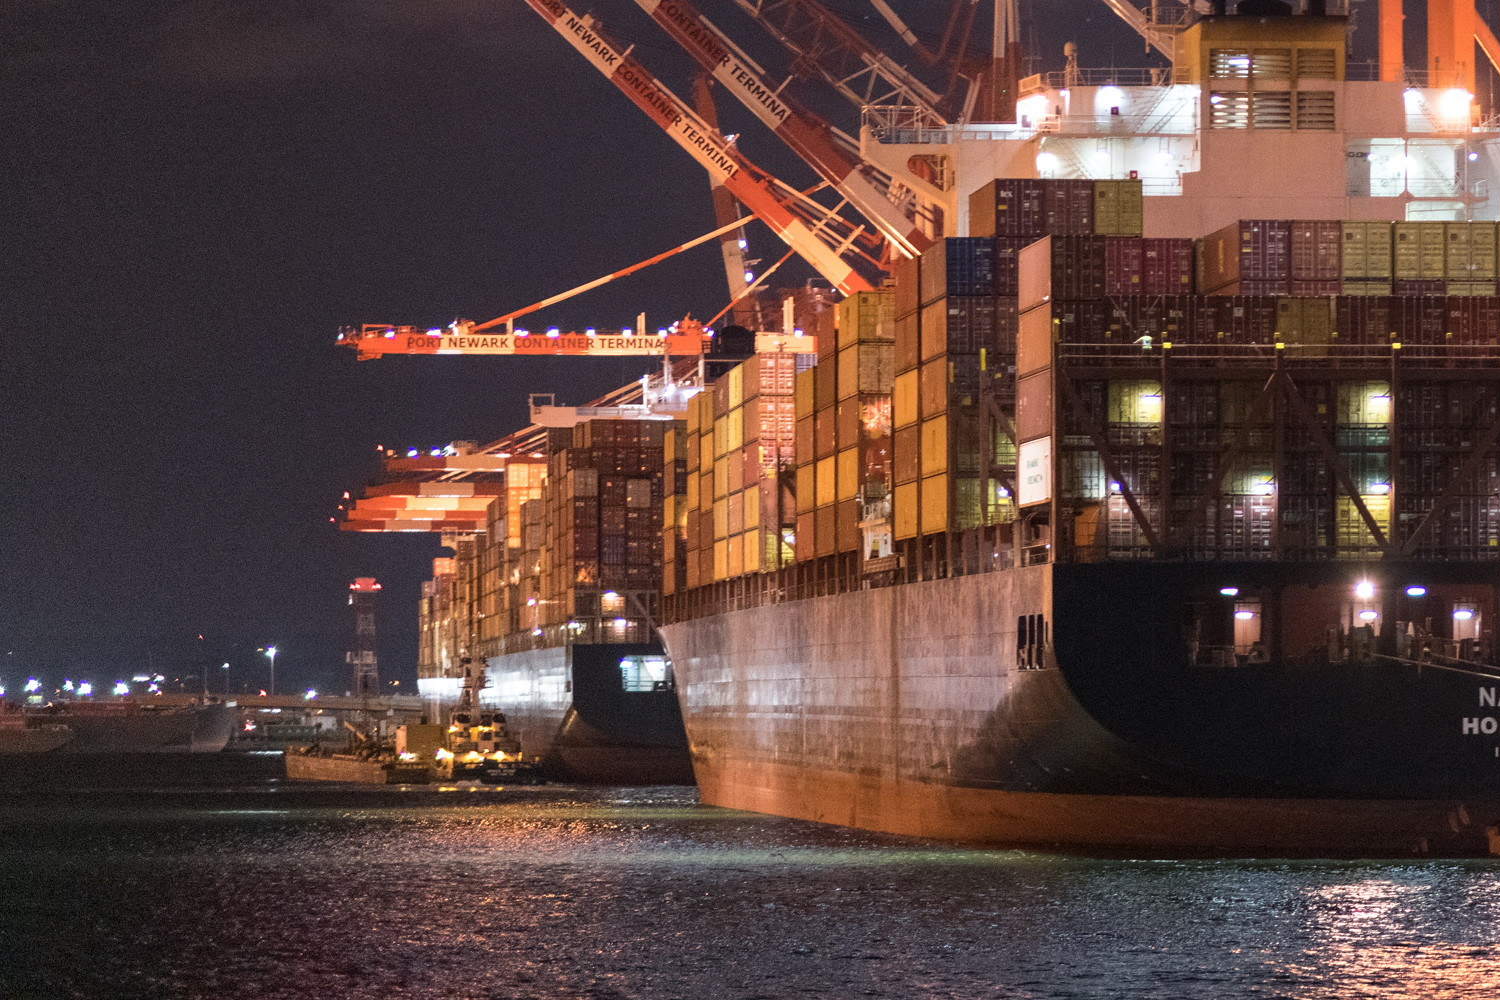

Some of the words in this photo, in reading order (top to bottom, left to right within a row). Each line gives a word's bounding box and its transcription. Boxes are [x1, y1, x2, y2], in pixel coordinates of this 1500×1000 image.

[659, 0, 731, 67] CONTAINER
[566, 17, 617, 66] NEWARK
[617, 63, 682, 127] CONTAINER
[682, 123, 740, 180] TERMINAL
[407, 337, 443, 348] PORT
[449, 338, 508, 348] NEWARK
[514, 338, 595, 348] CONTAINER
[599, 338, 664, 348] TERMINA
